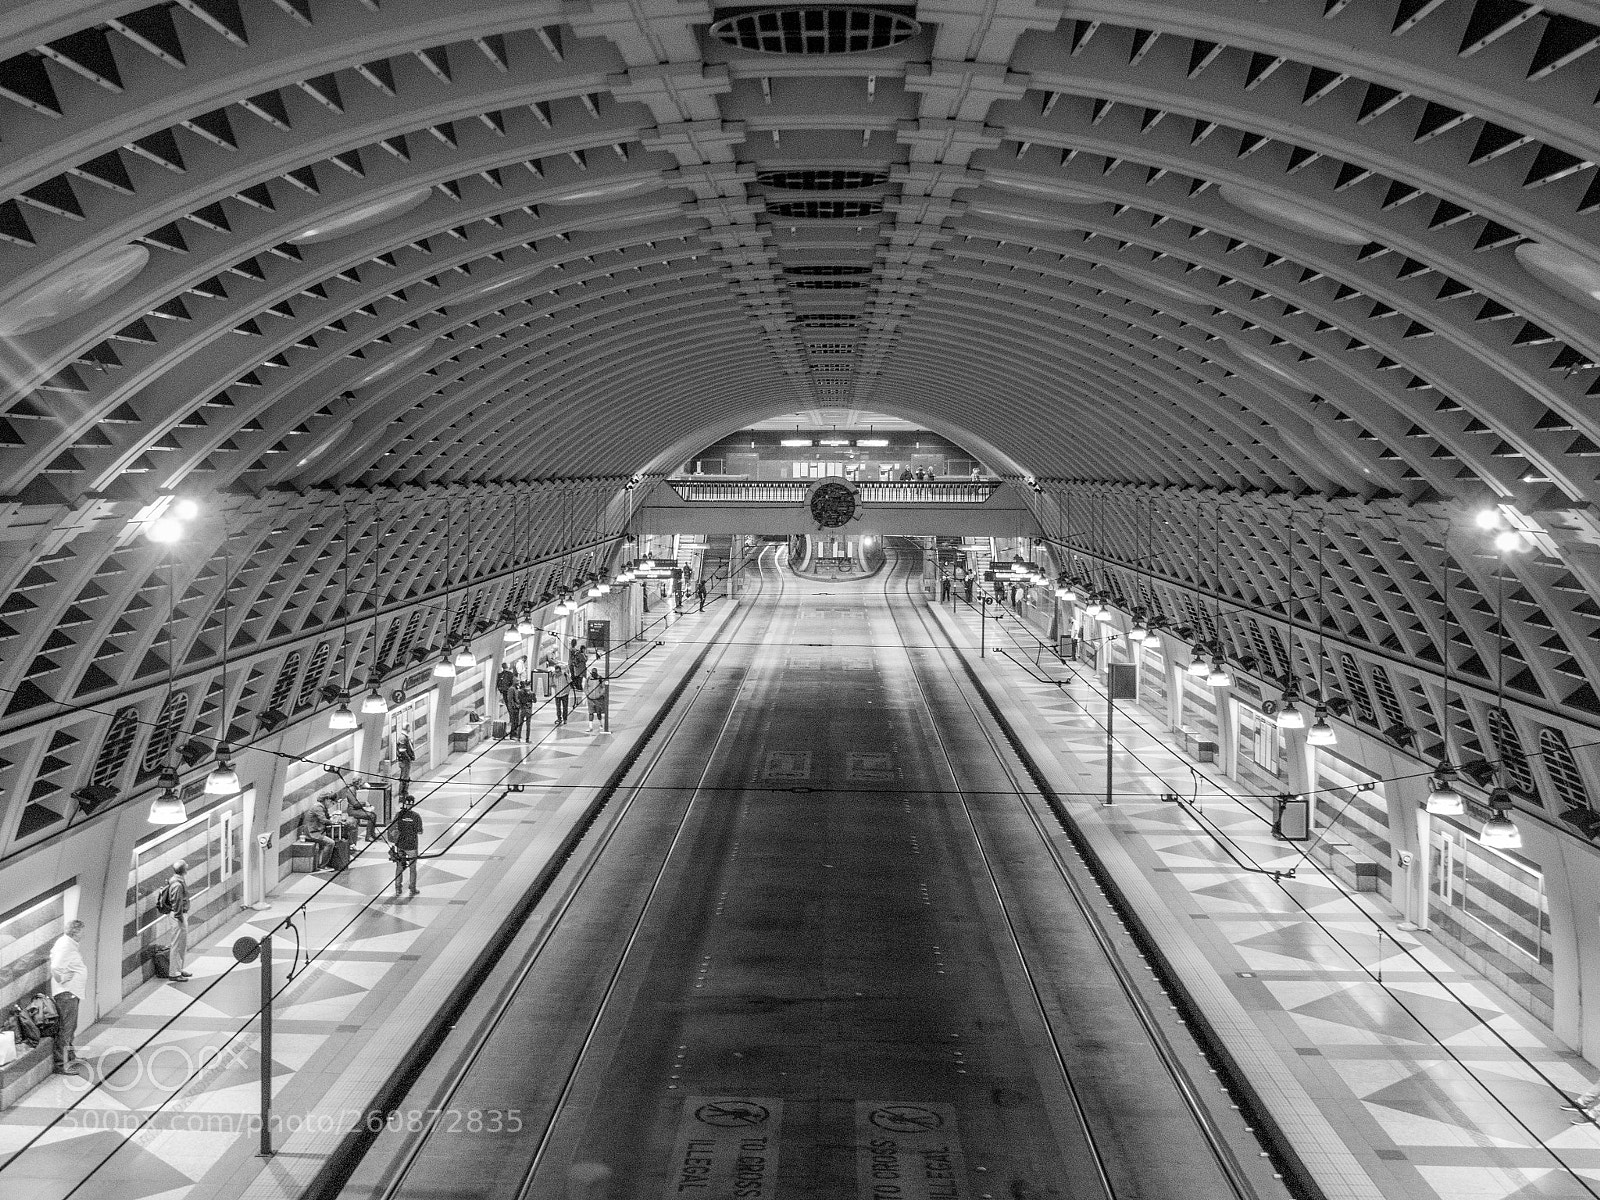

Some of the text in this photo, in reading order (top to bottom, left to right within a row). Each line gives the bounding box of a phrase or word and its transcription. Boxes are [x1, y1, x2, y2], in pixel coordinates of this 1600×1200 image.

[678, 1139, 716, 1192] ILLEGAL
[733, 1136, 768, 1197] TO CROSS
[869, 1140, 902, 1200] TO CROSS
